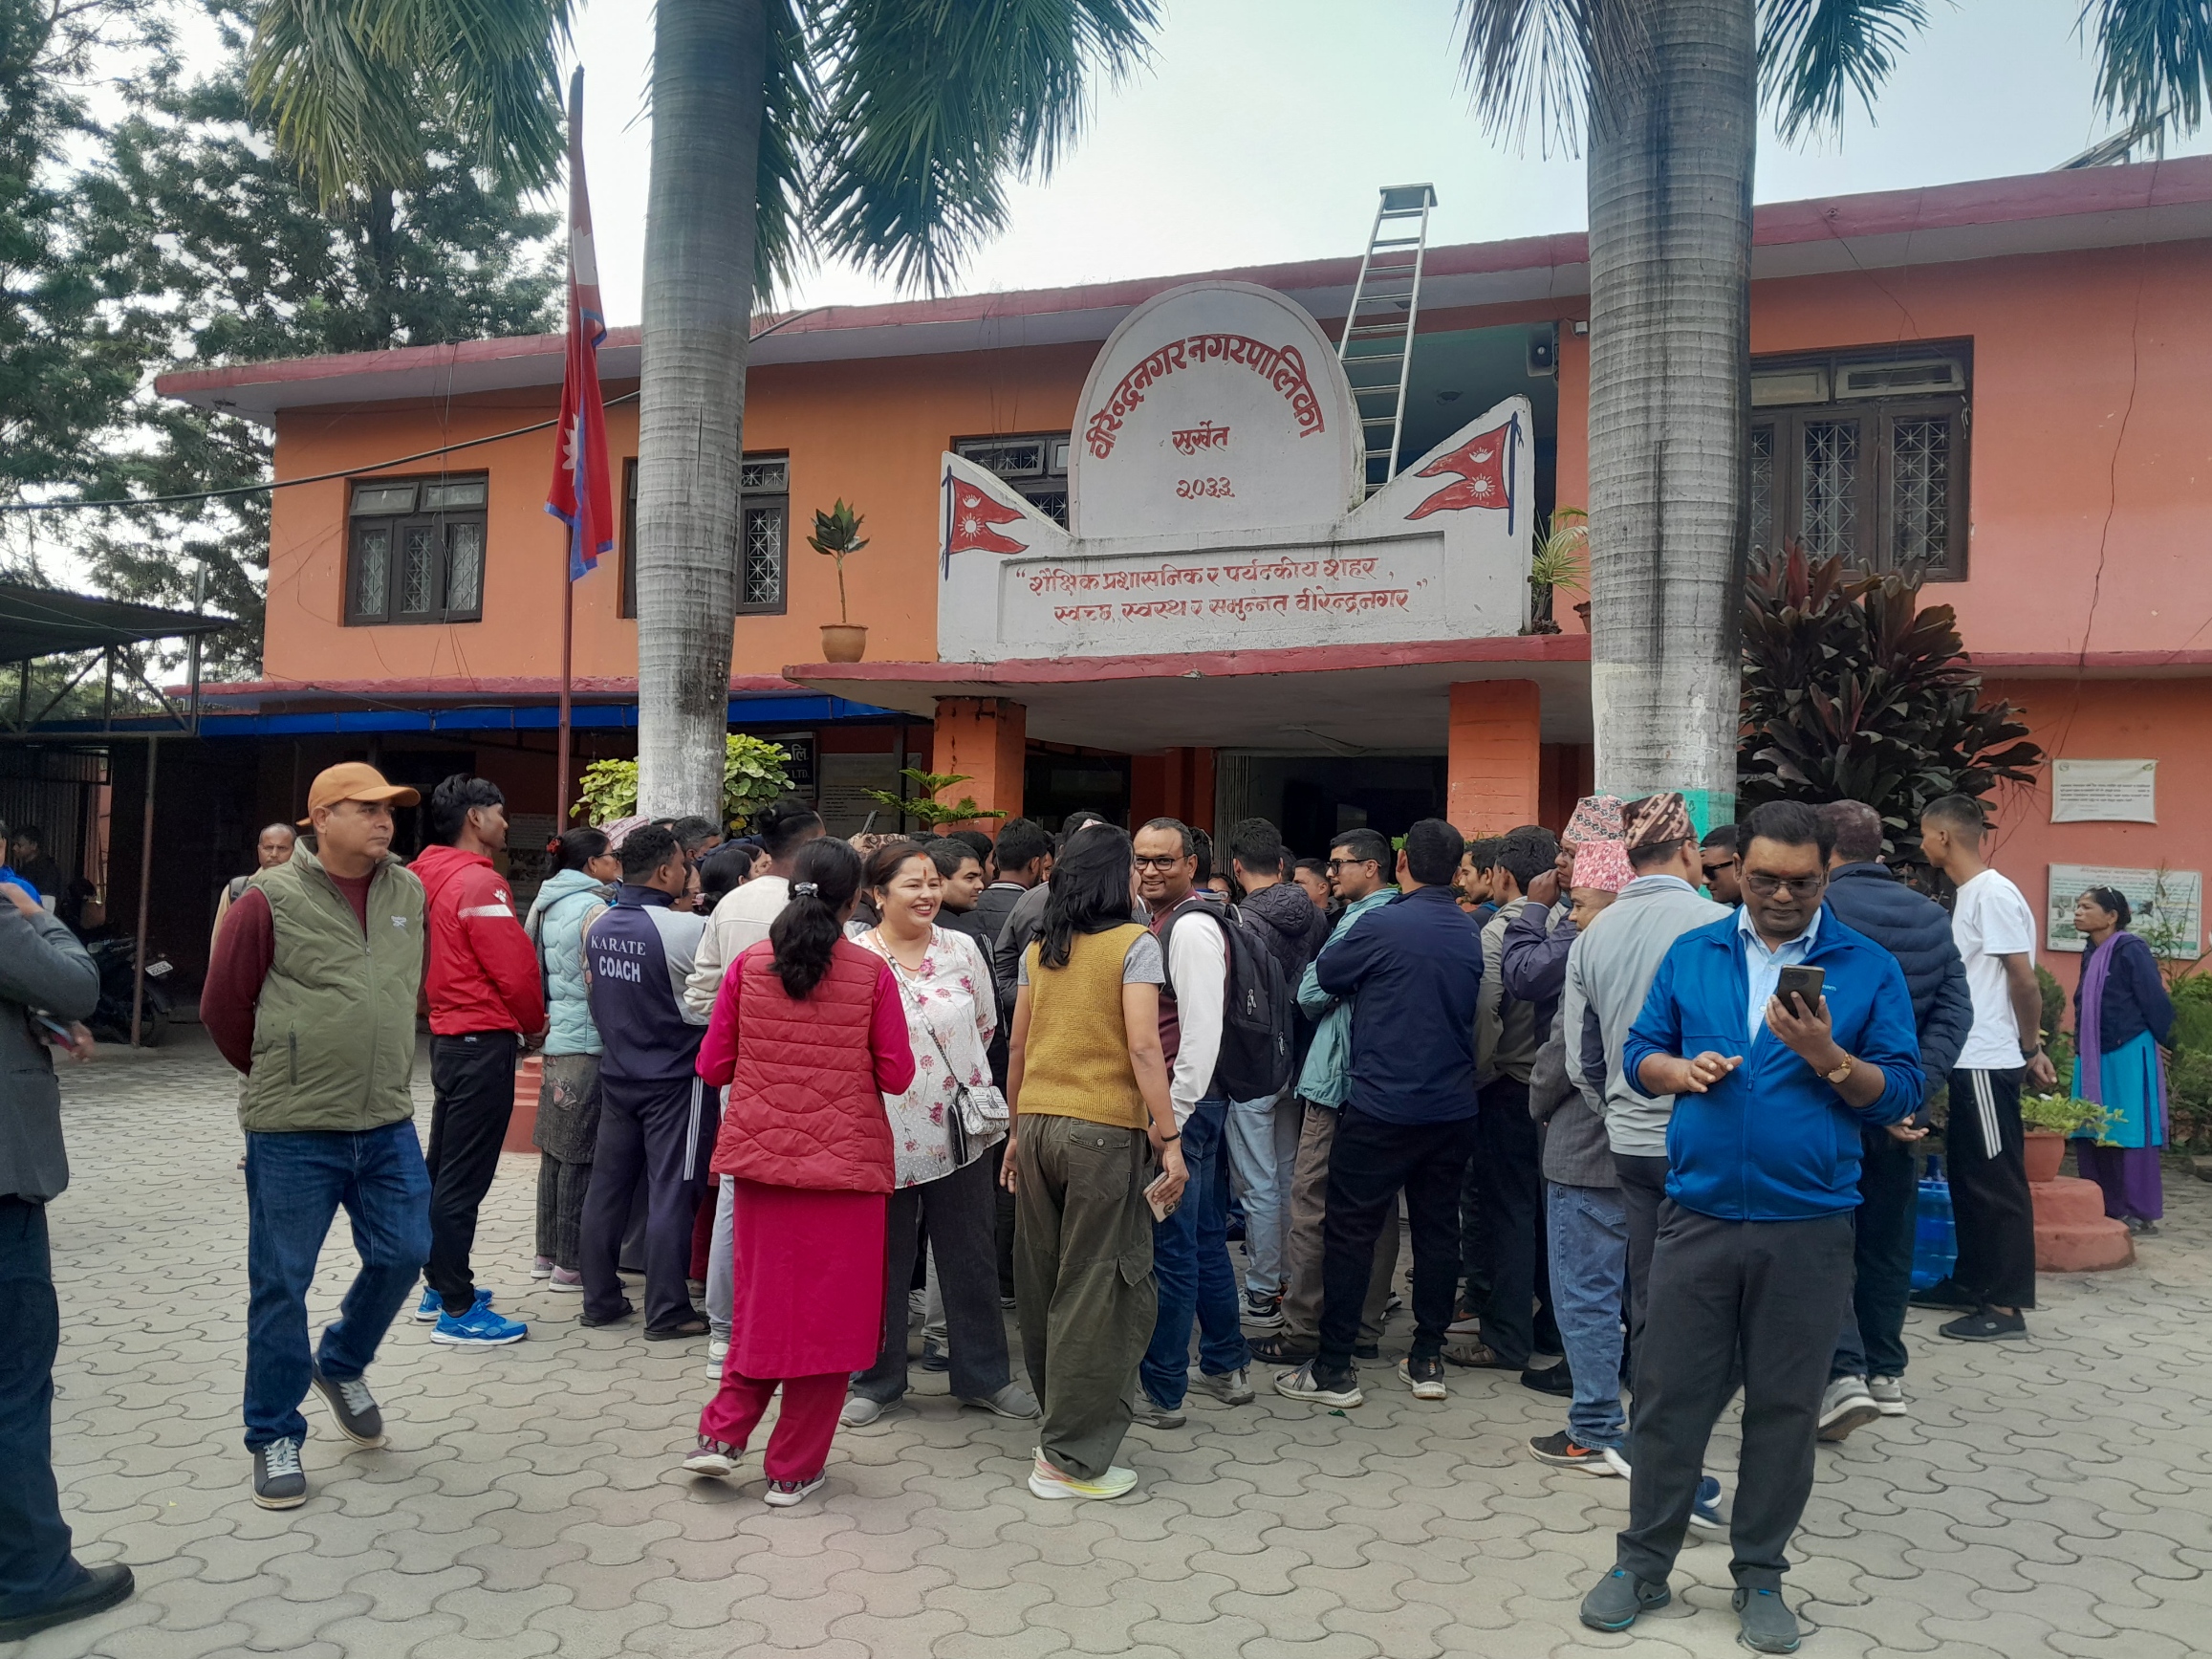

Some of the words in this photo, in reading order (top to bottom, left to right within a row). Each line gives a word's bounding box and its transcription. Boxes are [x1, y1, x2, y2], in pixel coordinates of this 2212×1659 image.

[1172, 420, 1230, 456] सुर्खेत
[1176, 476, 1236, 499] २०३३
[591, 934, 646, 956] KARATE
[598, 955, 641, 983] COACH
